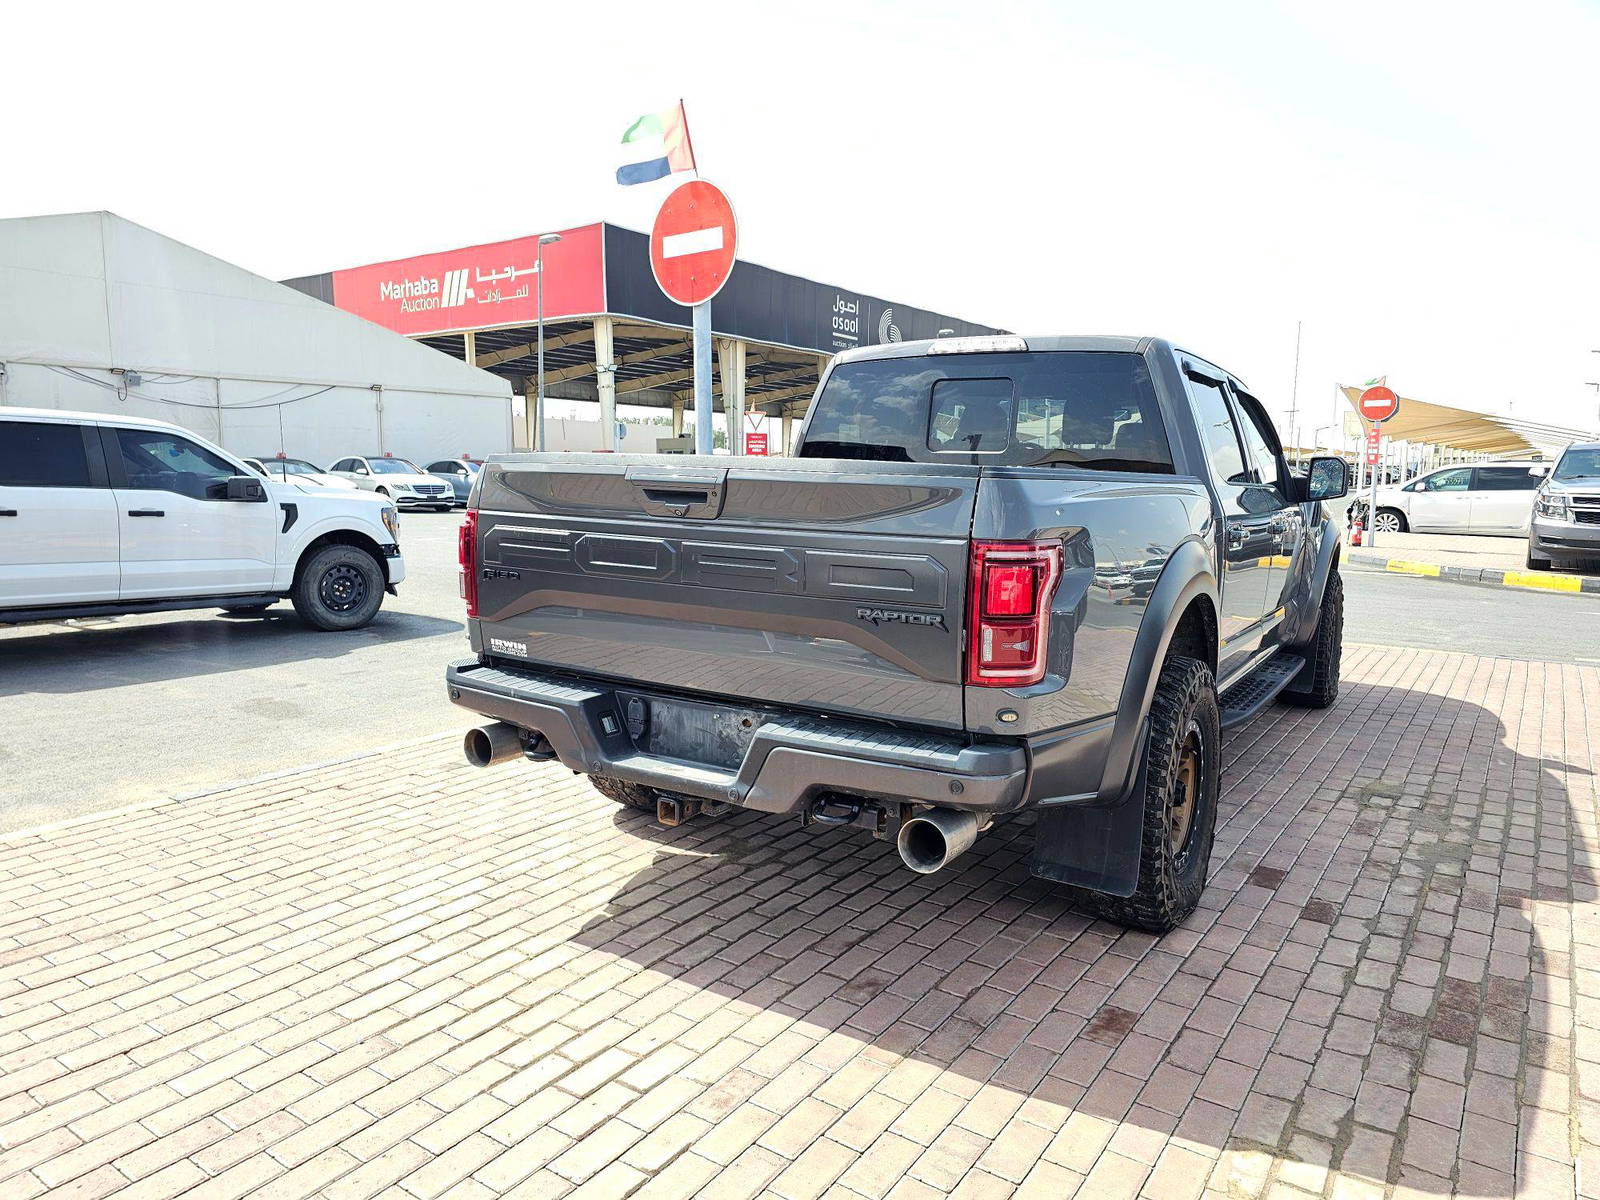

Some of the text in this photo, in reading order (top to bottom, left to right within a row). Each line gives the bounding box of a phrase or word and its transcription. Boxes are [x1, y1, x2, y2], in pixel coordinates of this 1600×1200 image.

[380, 277, 438, 300] Marhaba
[400, 297, 439, 313] Auction
[856, 606, 950, 633] RAPTOR
[490, 637, 527, 651] IRWIN
